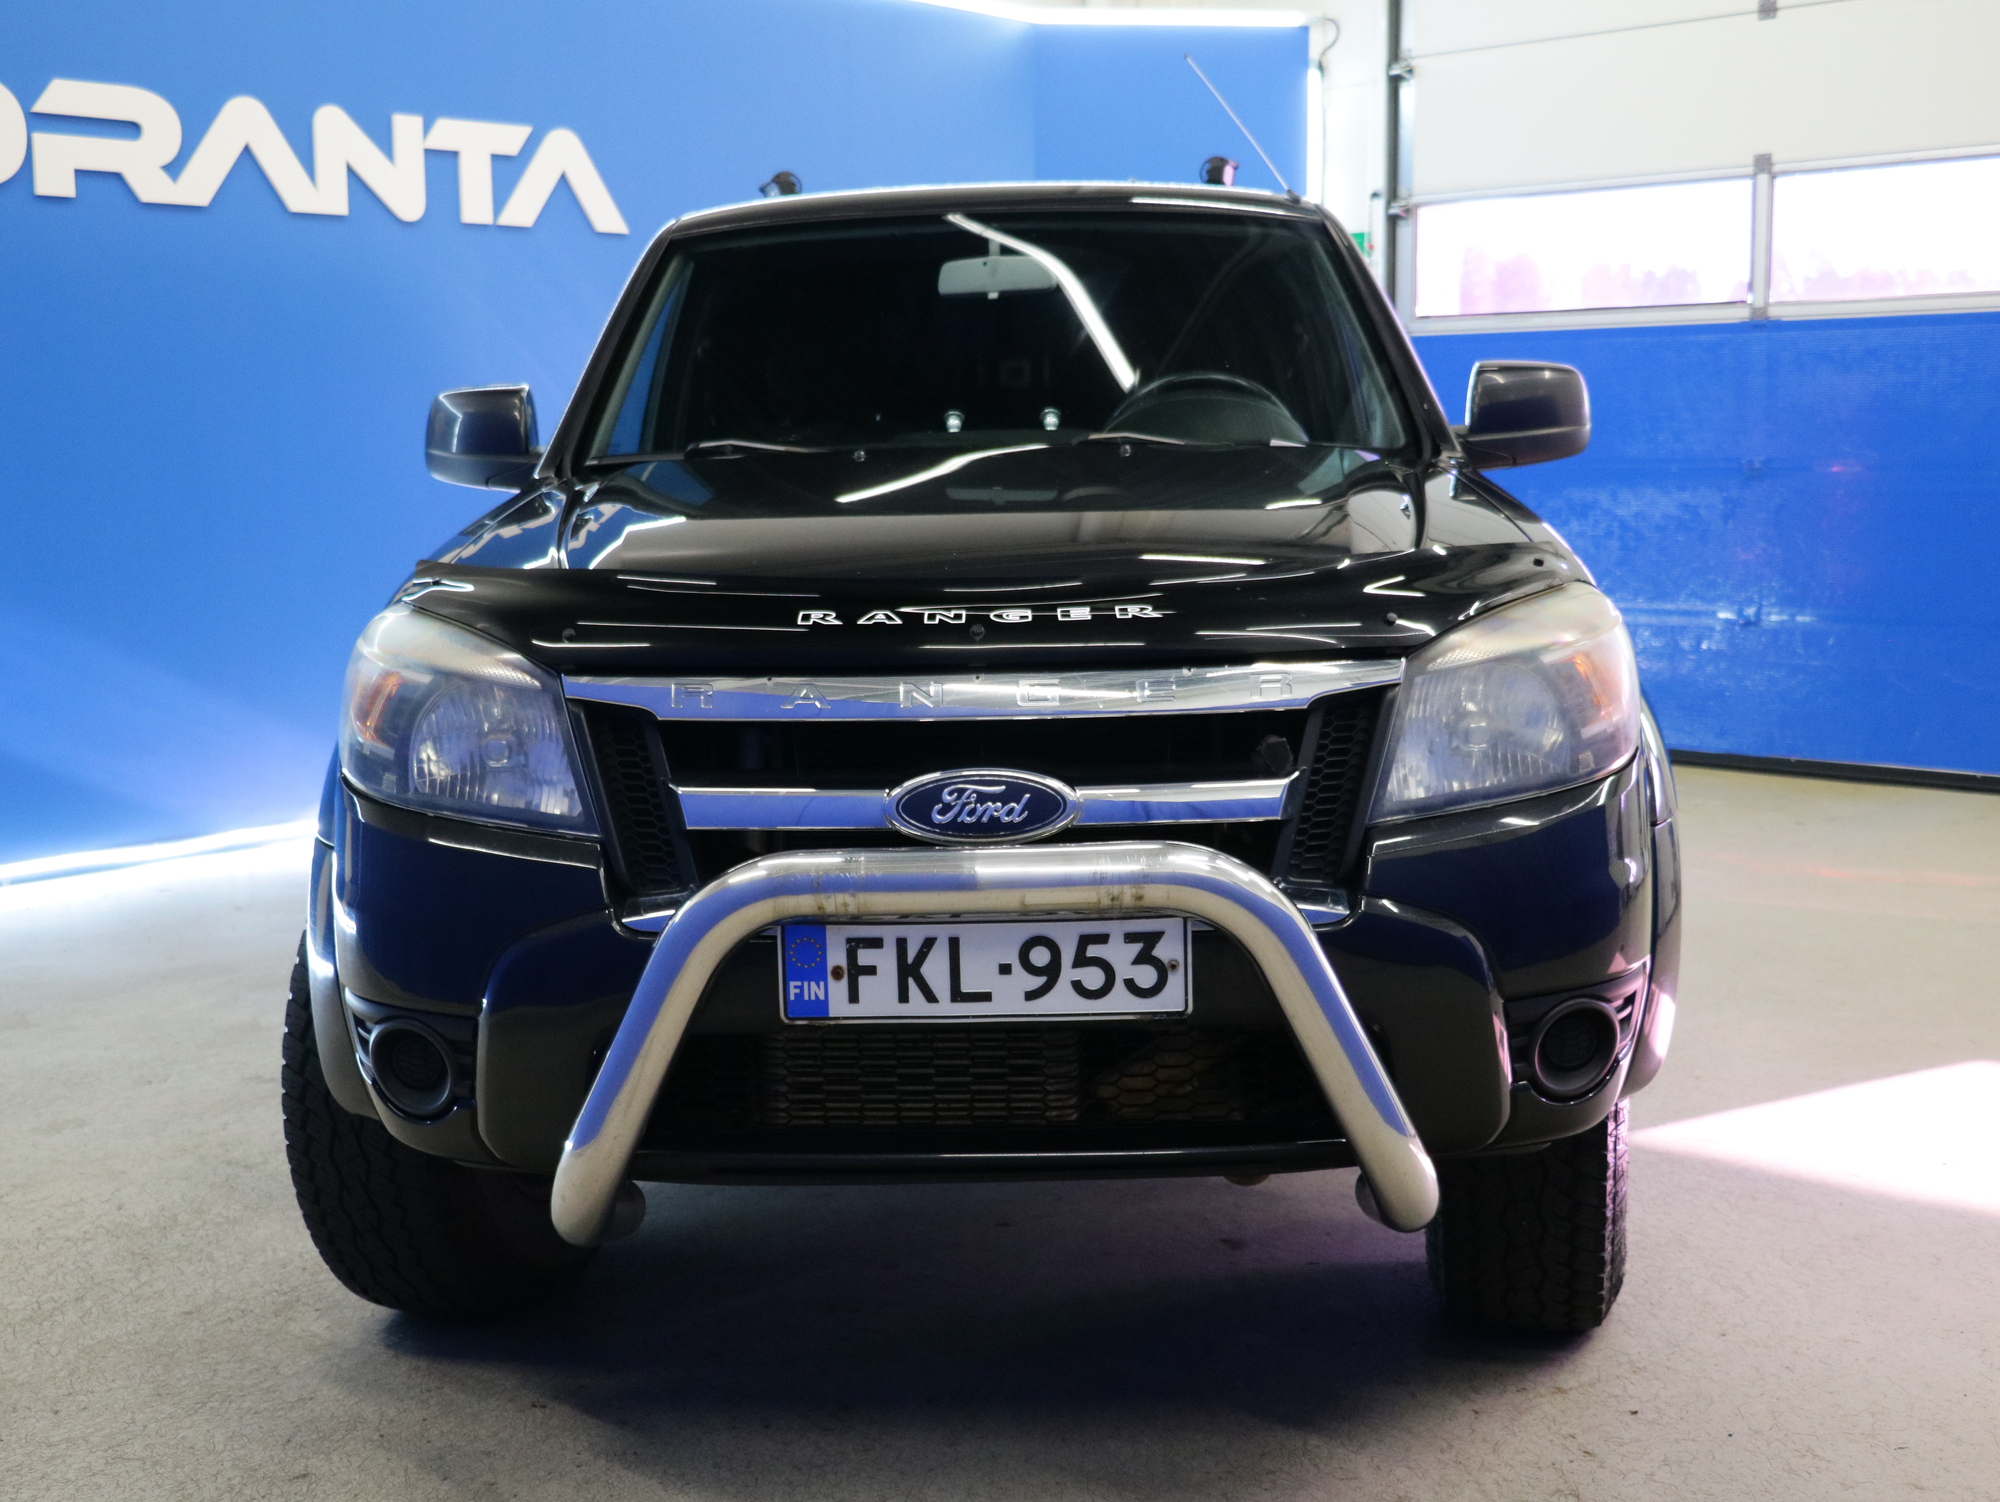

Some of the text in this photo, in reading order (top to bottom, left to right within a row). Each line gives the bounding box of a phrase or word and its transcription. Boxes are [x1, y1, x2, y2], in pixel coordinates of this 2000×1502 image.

[0, 78, 630, 235] RANTA
[797, 604, 1164, 625] RANGER
[670, 672, 1293, 710] RANGER
[931, 783, 1031, 824] Ford
[845, 930, 1169, 1005] FKL-953
[788, 980, 826, 1001] FIN
